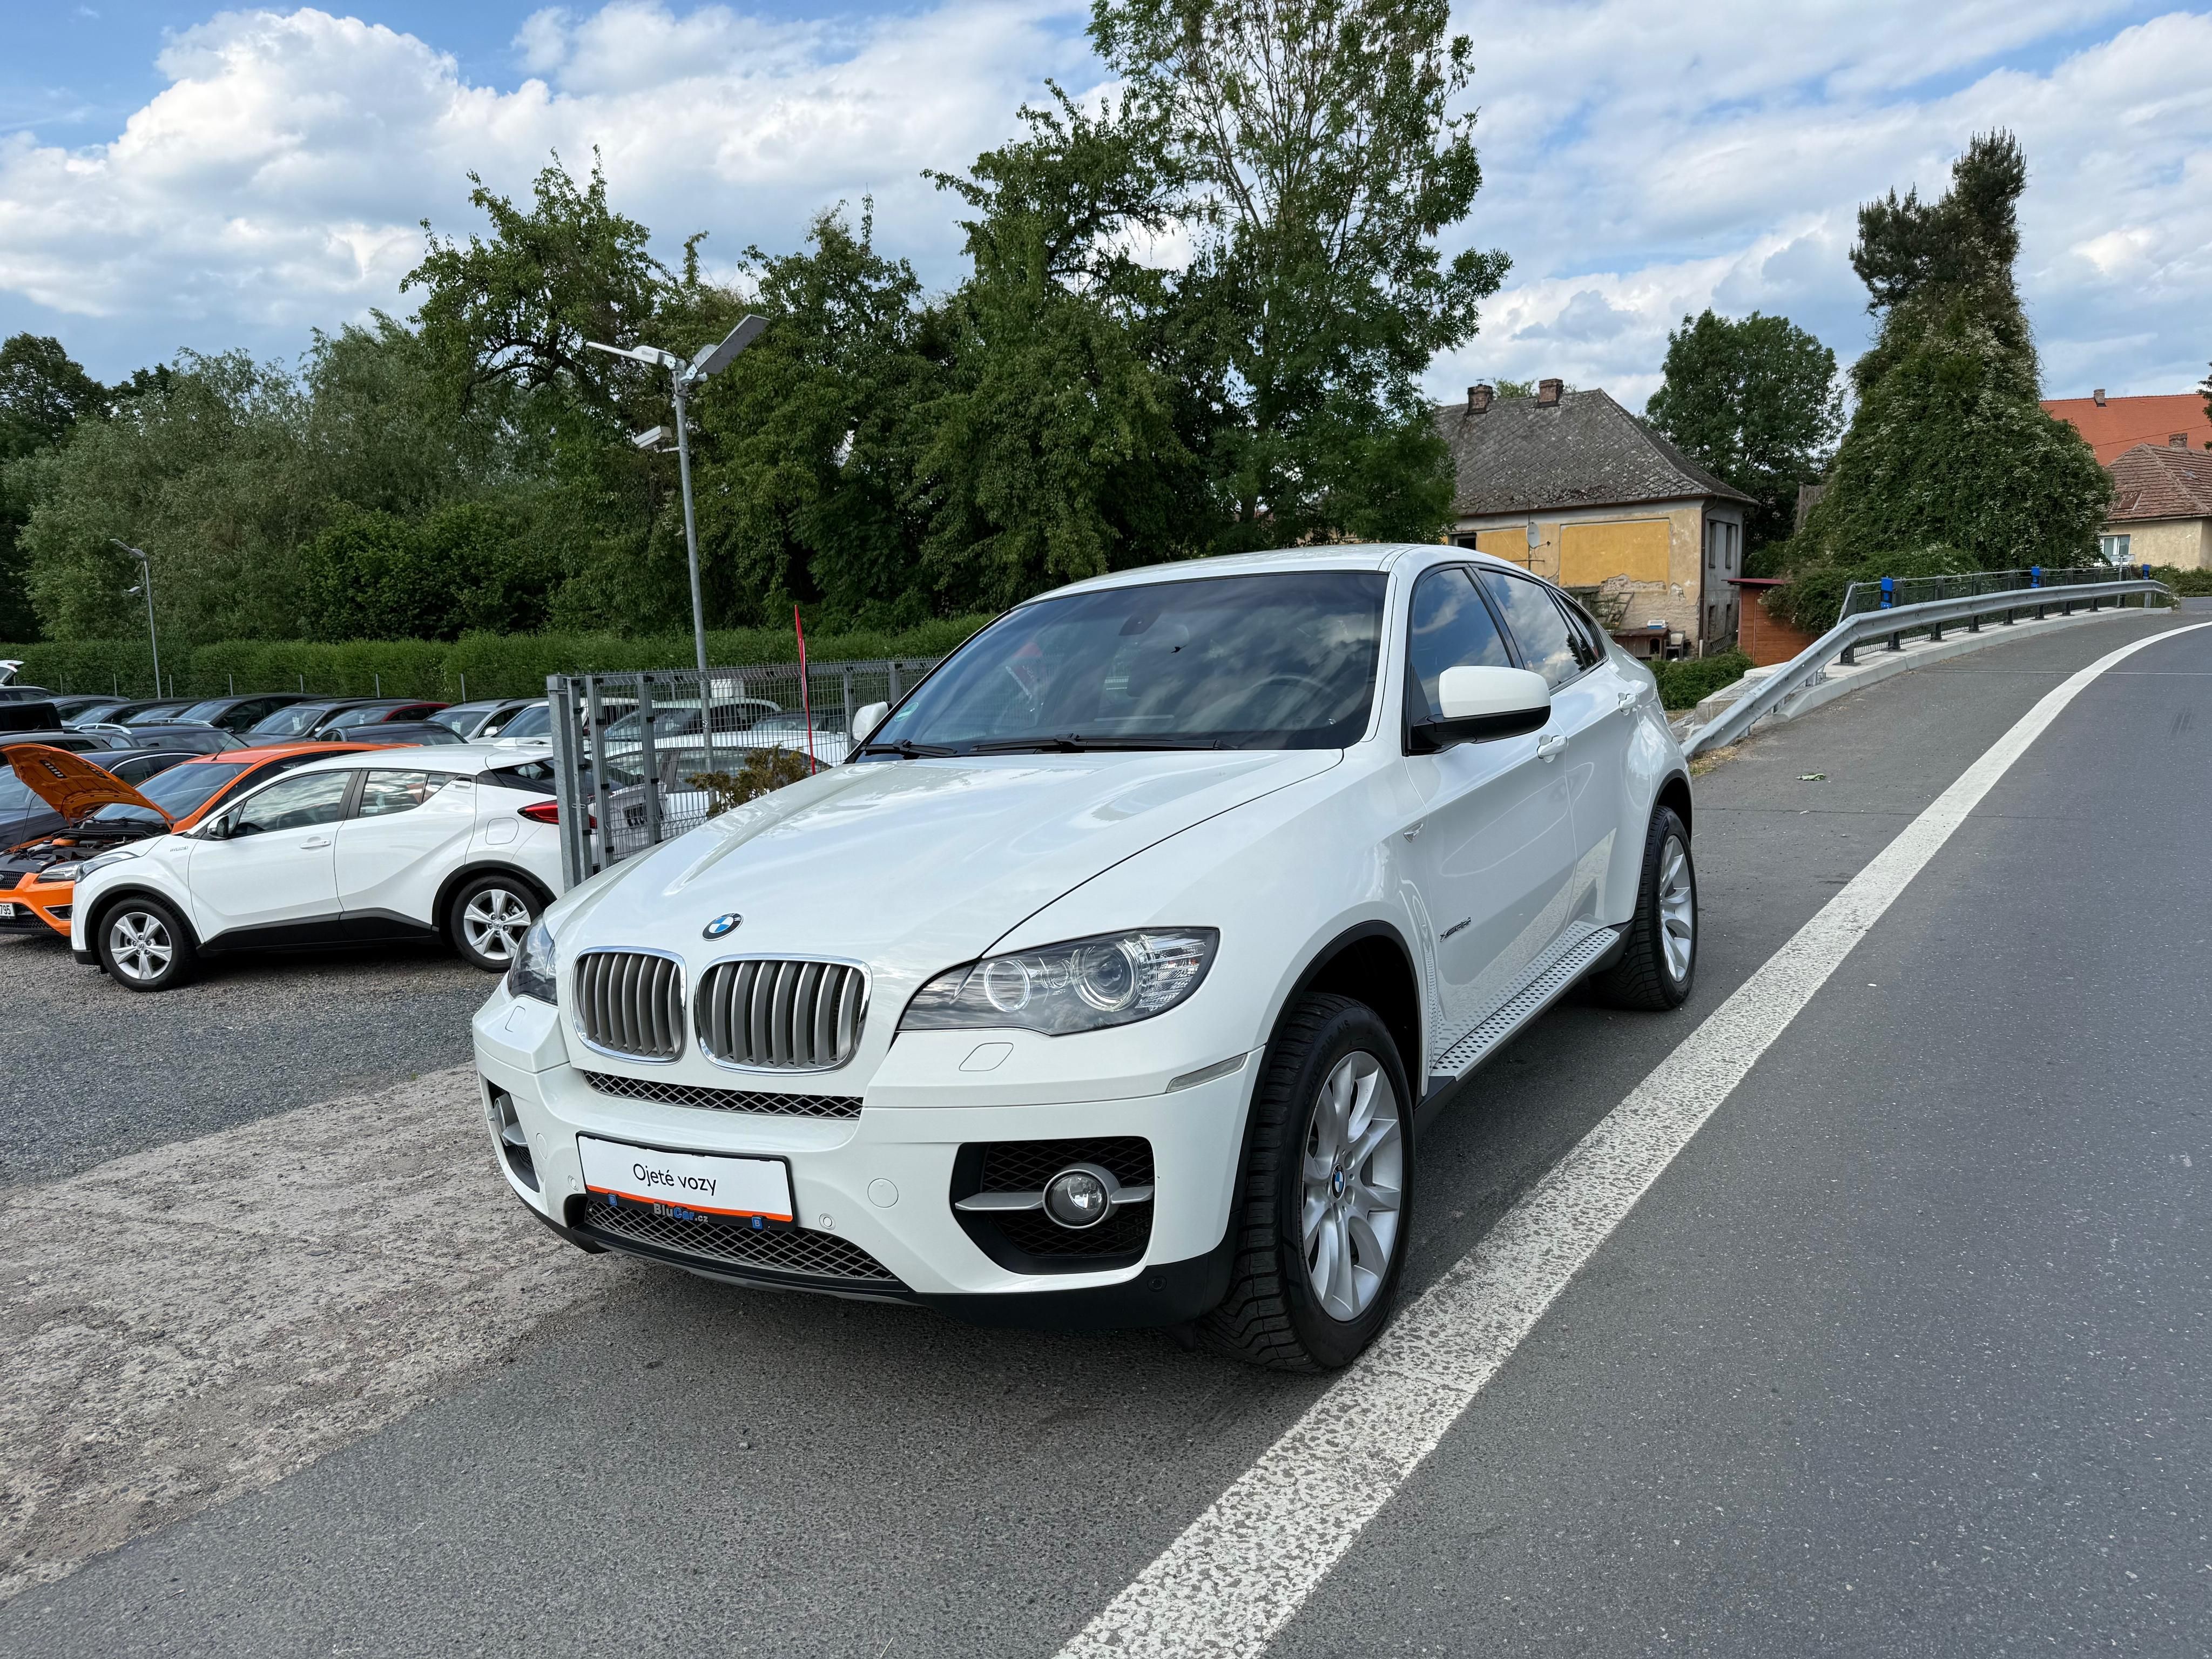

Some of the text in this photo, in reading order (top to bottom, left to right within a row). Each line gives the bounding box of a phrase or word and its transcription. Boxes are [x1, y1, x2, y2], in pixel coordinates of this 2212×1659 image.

[0, 905, 11, 915] 795
[633, 1163, 716, 1196] Ojeté vozy
[653, 1203, 709, 1223] BluCar.cz
